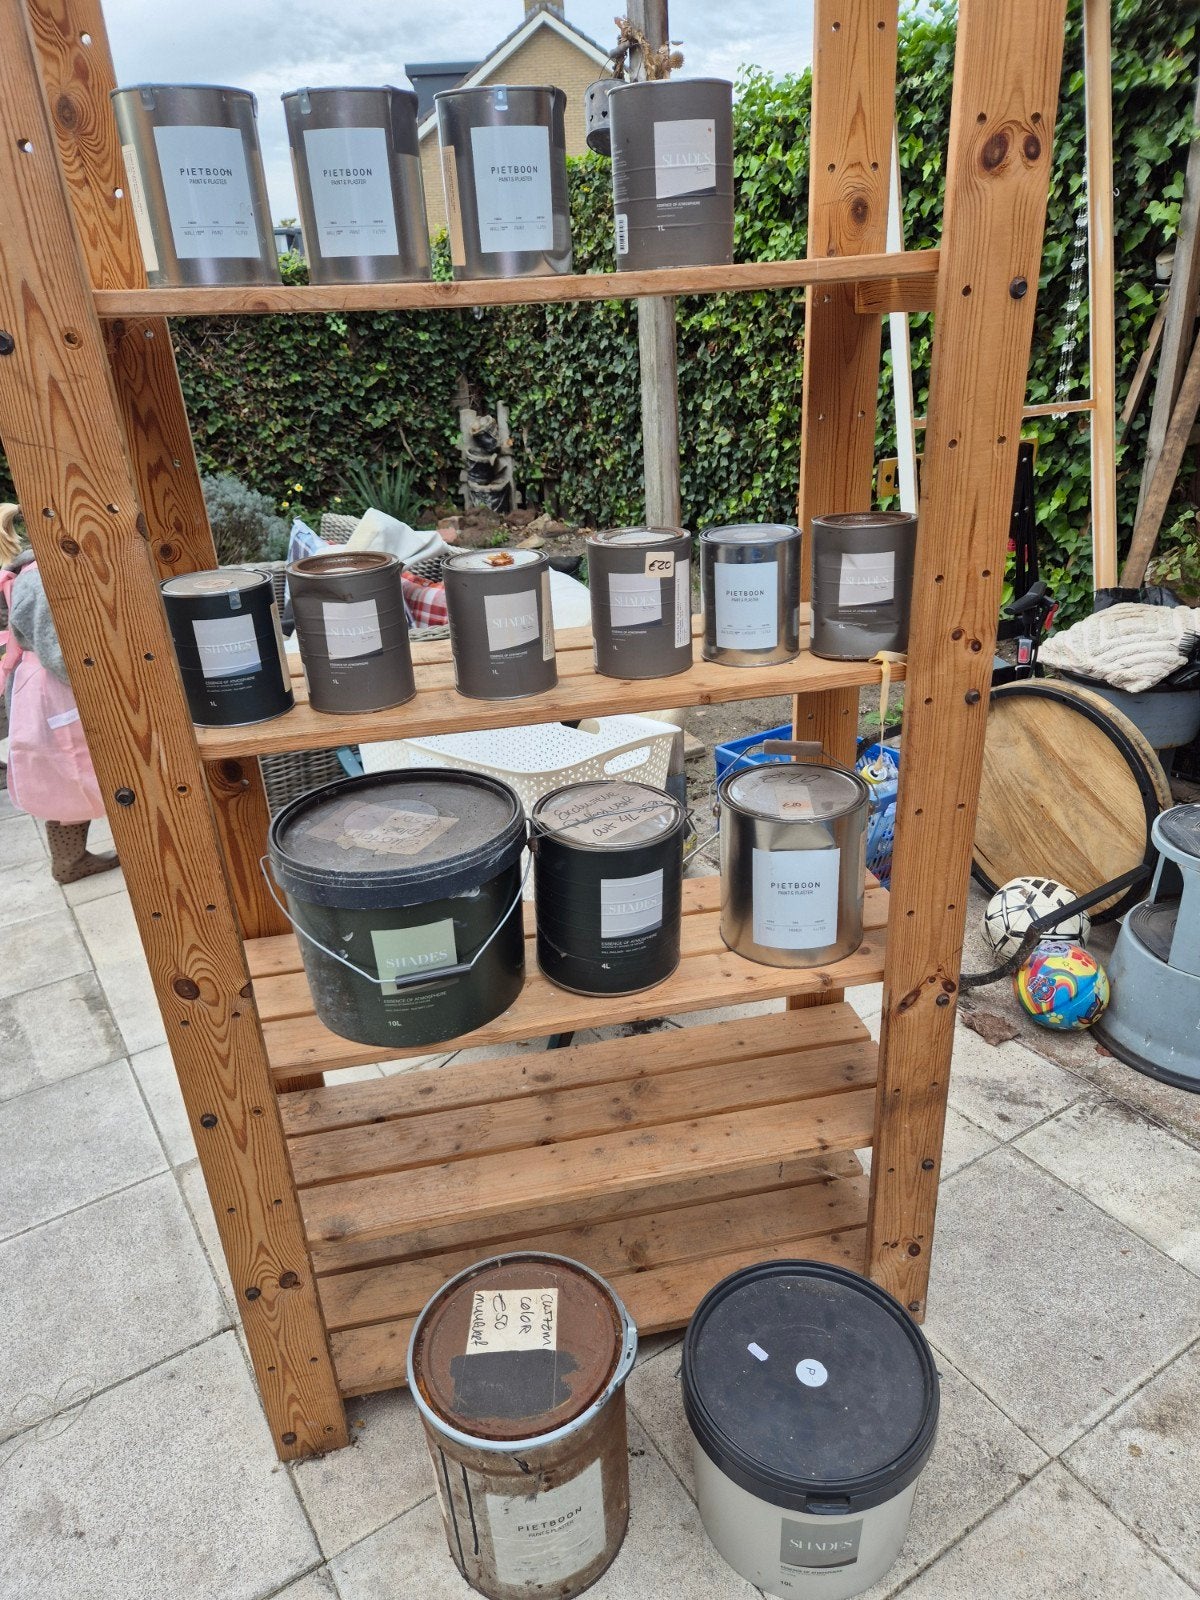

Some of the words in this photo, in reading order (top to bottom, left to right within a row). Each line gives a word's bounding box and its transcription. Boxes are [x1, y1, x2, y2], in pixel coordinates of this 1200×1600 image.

[662, 151, 711, 167] SHADES
[179, 167, 232, 176] PIETBOON
[323, 168, 373, 177] PIETBOON
[490, 165, 538, 174] PIETBOON
[648, 559, 671, 572] €20
[492, 613, 535, 628] SHADES
[770, 881, 821, 889] PIETBOON
[608, 897, 658, 914] SHADES
[386, 949, 449, 968] SHADES
[492, 1293, 509, 1330] €50
[517, 1506, 583, 1532] PIETBOON
[789, 1538, 853, 1551] SHADES
